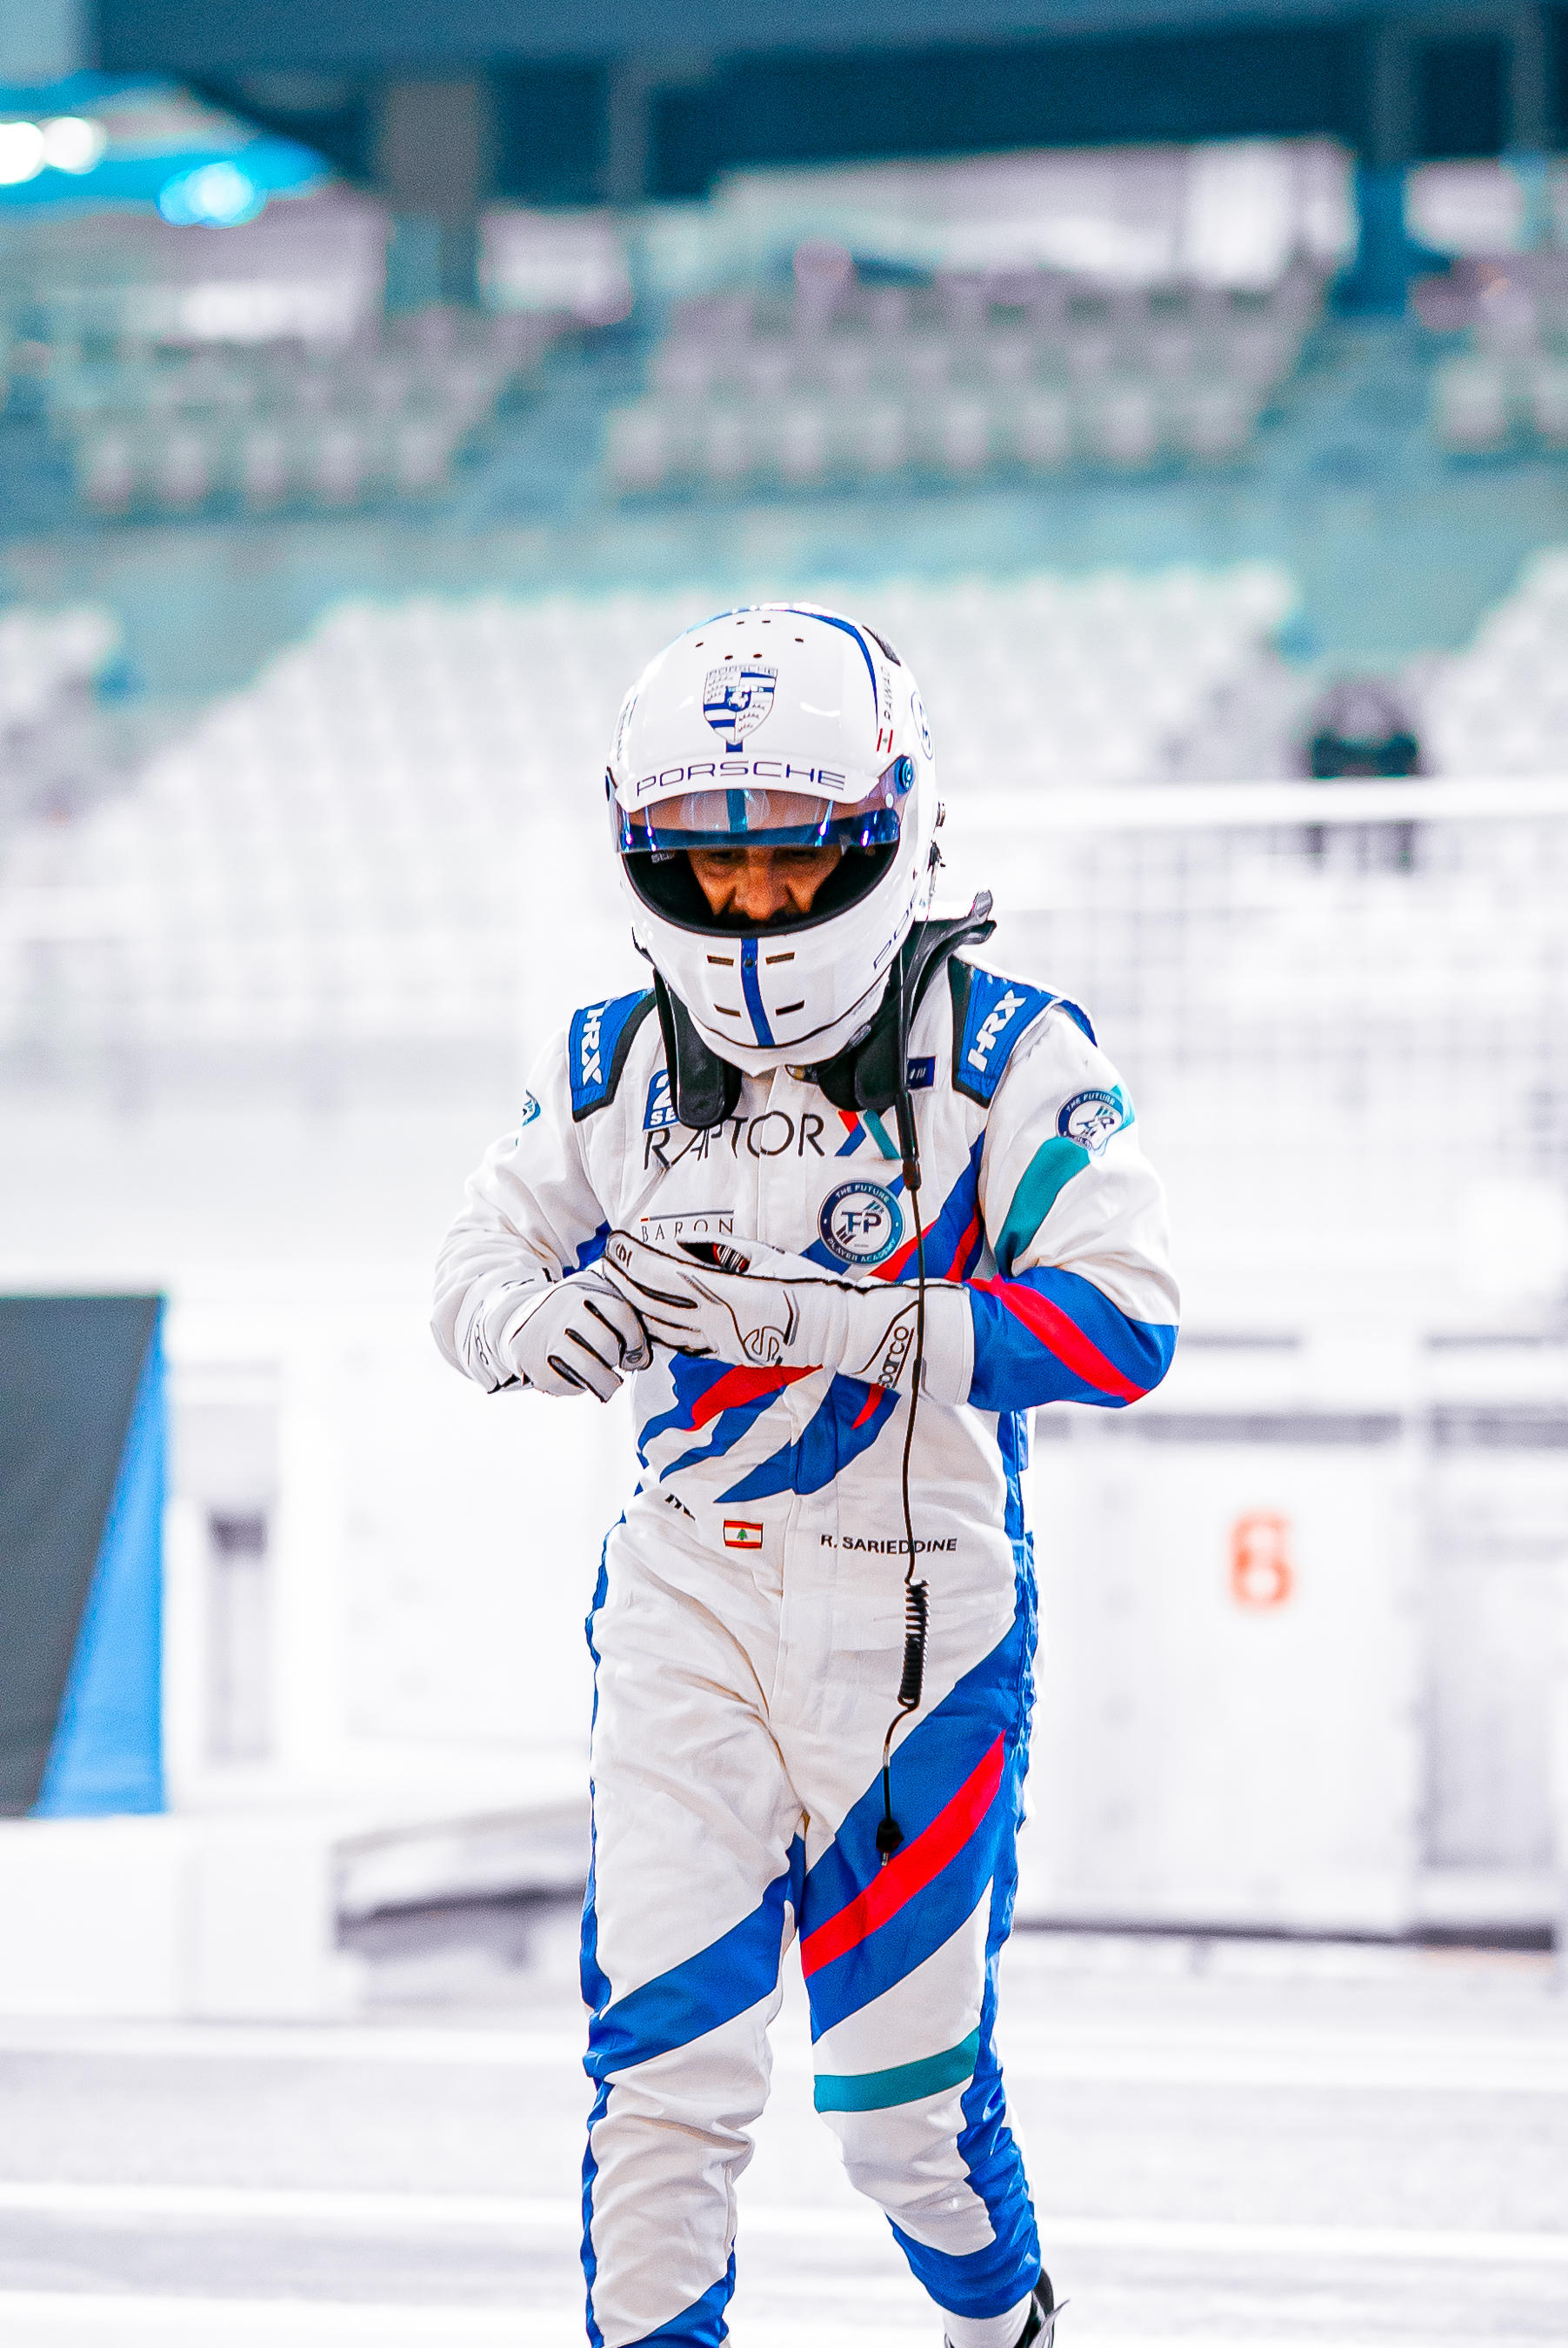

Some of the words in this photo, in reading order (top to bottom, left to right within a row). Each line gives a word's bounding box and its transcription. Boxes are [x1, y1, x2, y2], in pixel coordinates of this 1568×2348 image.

[637, 760, 846, 797] PORSCHE
[581, 1007, 606, 1085] HRX
[967, 989, 1027, 1073] HRX
[835, 1185, 852, 1198] THE
[854, 1184, 891, 1204] FUTURE
[642, 1217, 734, 1243] BARON
[827, 1237, 857, 1262] PLAYER
[860, 1237, 896, 1264] ACADEMY
[877, 1325, 910, 1390] parco
[820, 1534, 837, 1550] R.
[842, 1536, 957, 1555] SARIEDDINE
